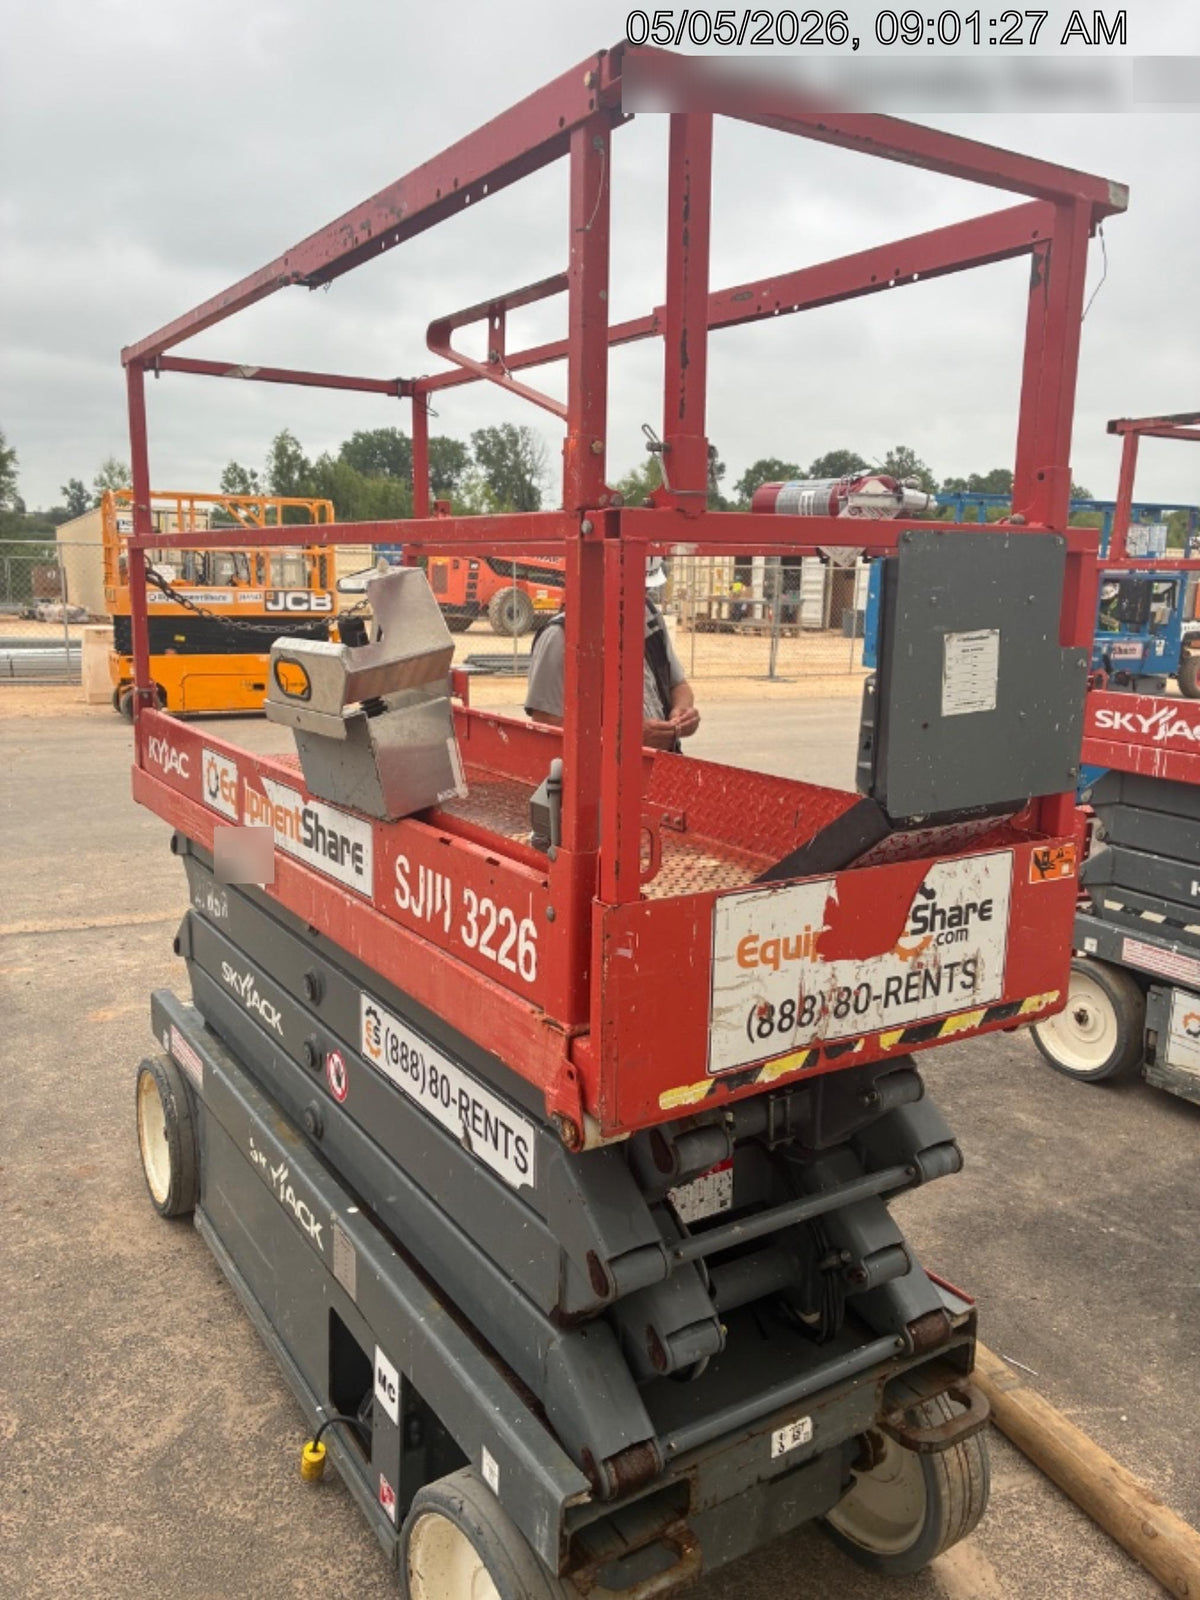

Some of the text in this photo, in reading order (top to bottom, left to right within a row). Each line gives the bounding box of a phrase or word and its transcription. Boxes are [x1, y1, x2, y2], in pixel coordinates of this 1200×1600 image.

[266, 592, 332, 610] JCB
[461, 887, 538, 982] 3226
[222, 961, 284, 1037] SKYJACK
[377, 1361, 396, 1404] MC
